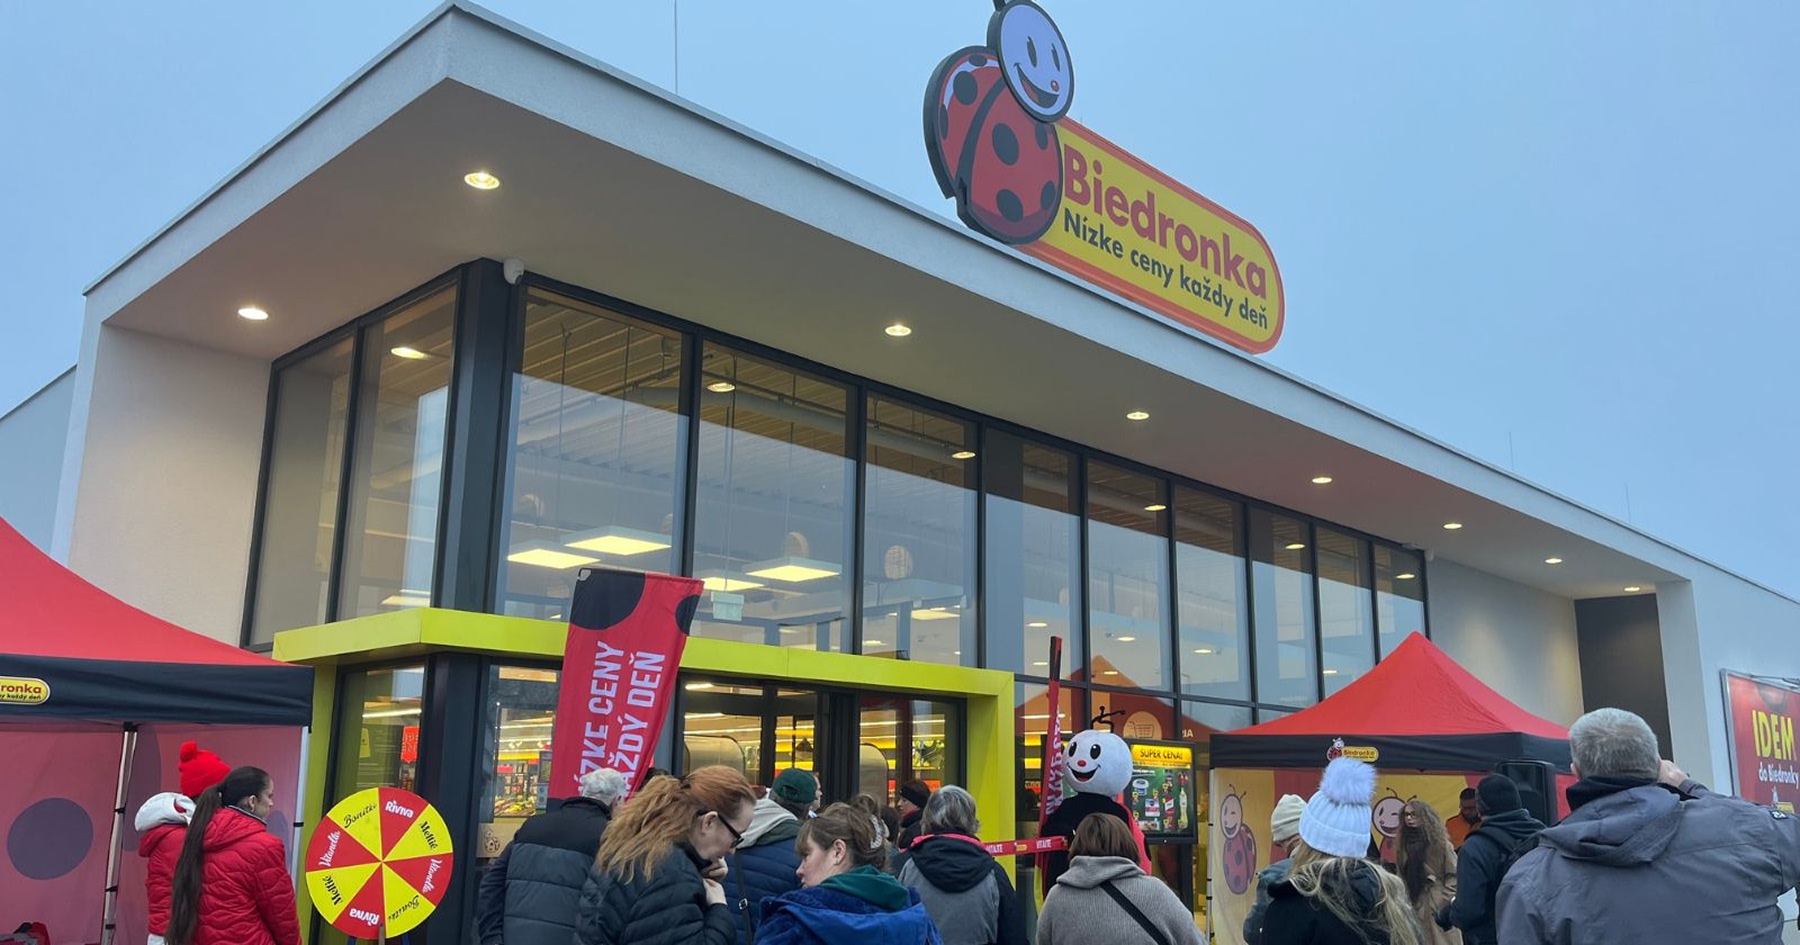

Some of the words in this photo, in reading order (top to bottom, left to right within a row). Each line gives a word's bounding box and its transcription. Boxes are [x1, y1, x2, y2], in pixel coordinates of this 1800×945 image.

[1063, 143, 1267, 300] Biedronka
[1063, 207, 1124, 259] Nízke
[1130, 249, 1174, 288] ceny
[1239, 297, 1268, 330] deň
[588, 640, 625, 716] CENY
[626, 651, 666, 708] DEŇ
[607, 713, 649, 798] AŽDÝ
[1751, 709, 1798, 762] IDEM
[1758, 761, 1768, 783] do
